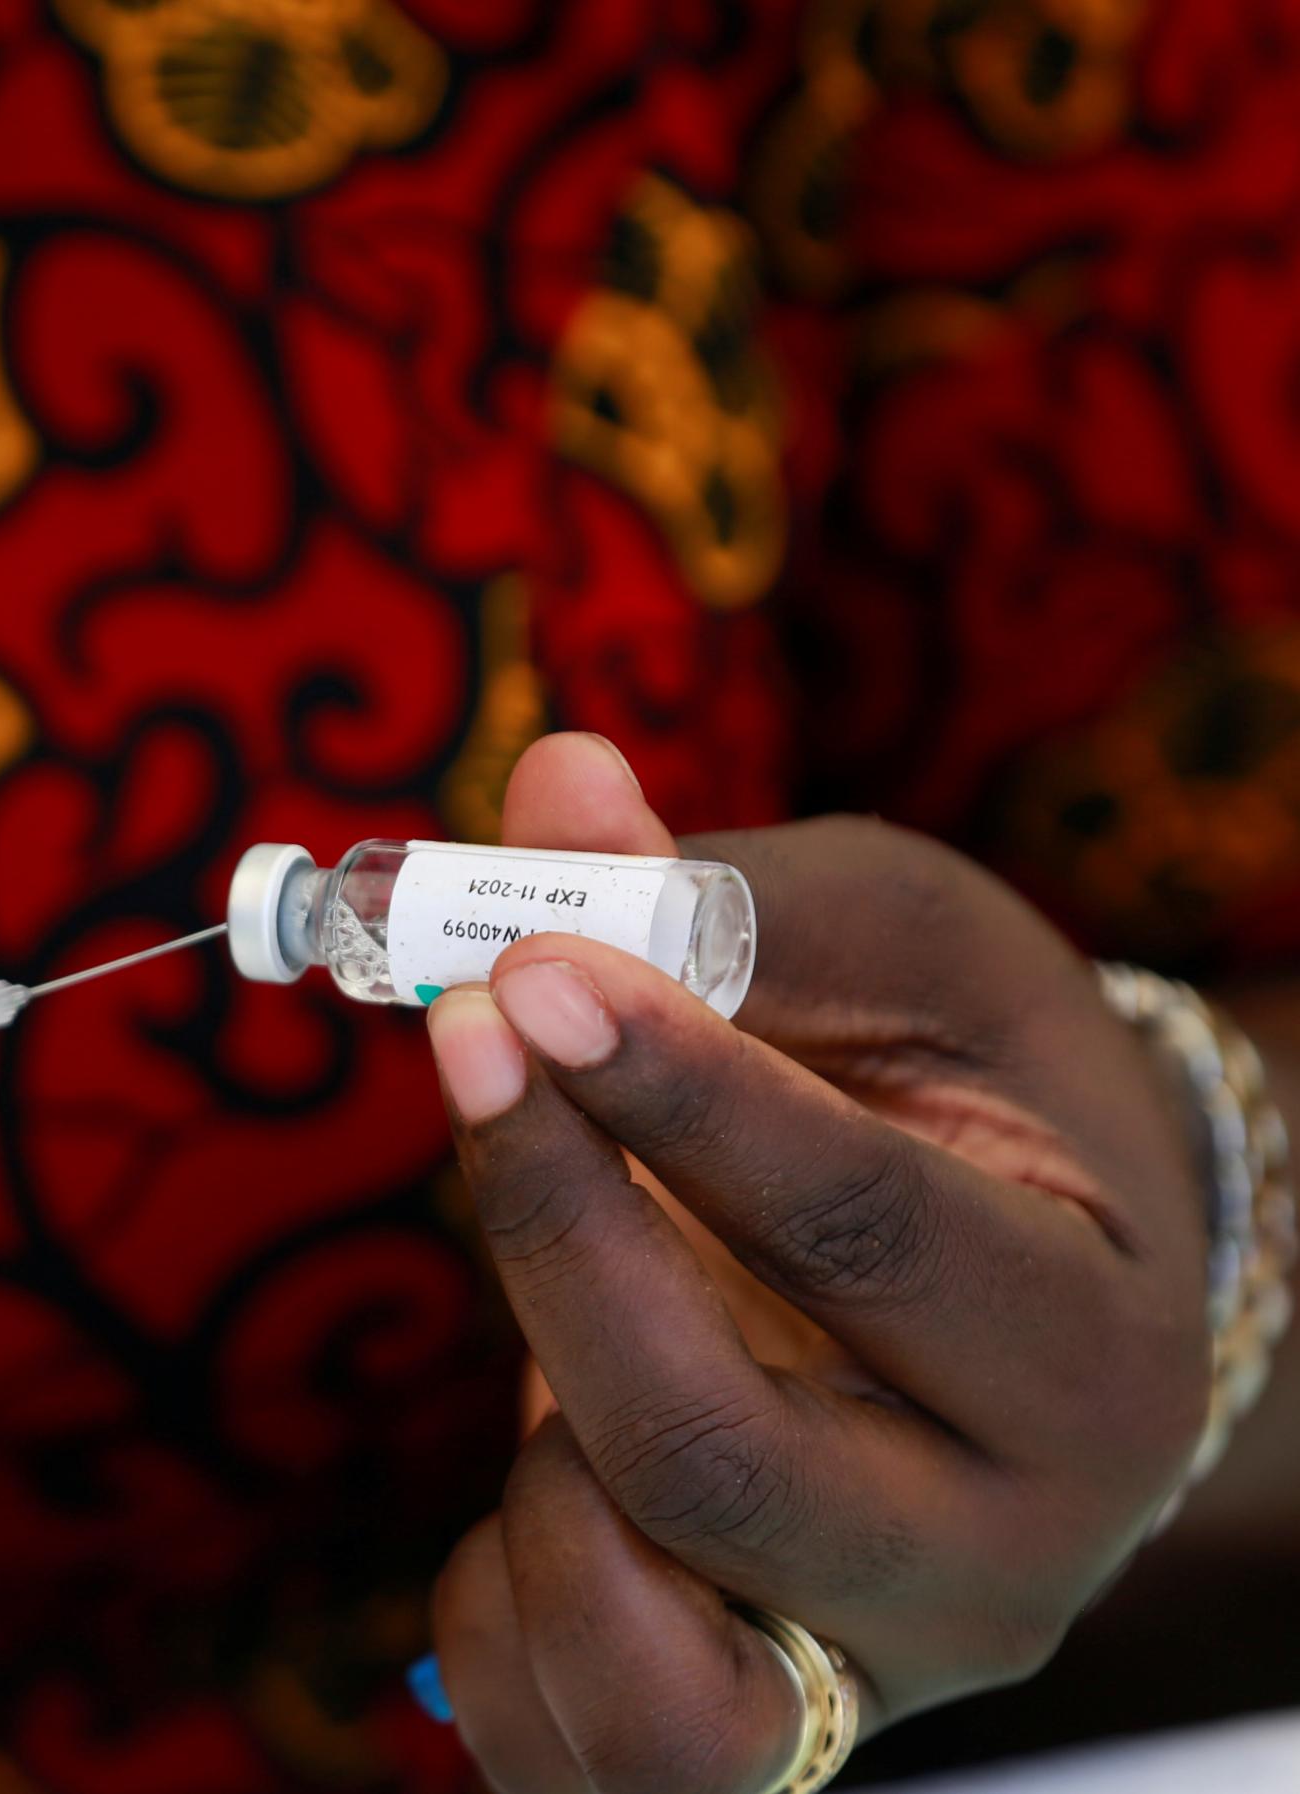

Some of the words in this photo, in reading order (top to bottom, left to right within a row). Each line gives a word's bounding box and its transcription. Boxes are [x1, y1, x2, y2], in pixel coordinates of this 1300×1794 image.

[468, 878, 537, 901] 11-2021
[545, 888, 587, 908] EXP
[443, 918, 535, 943] W40099
